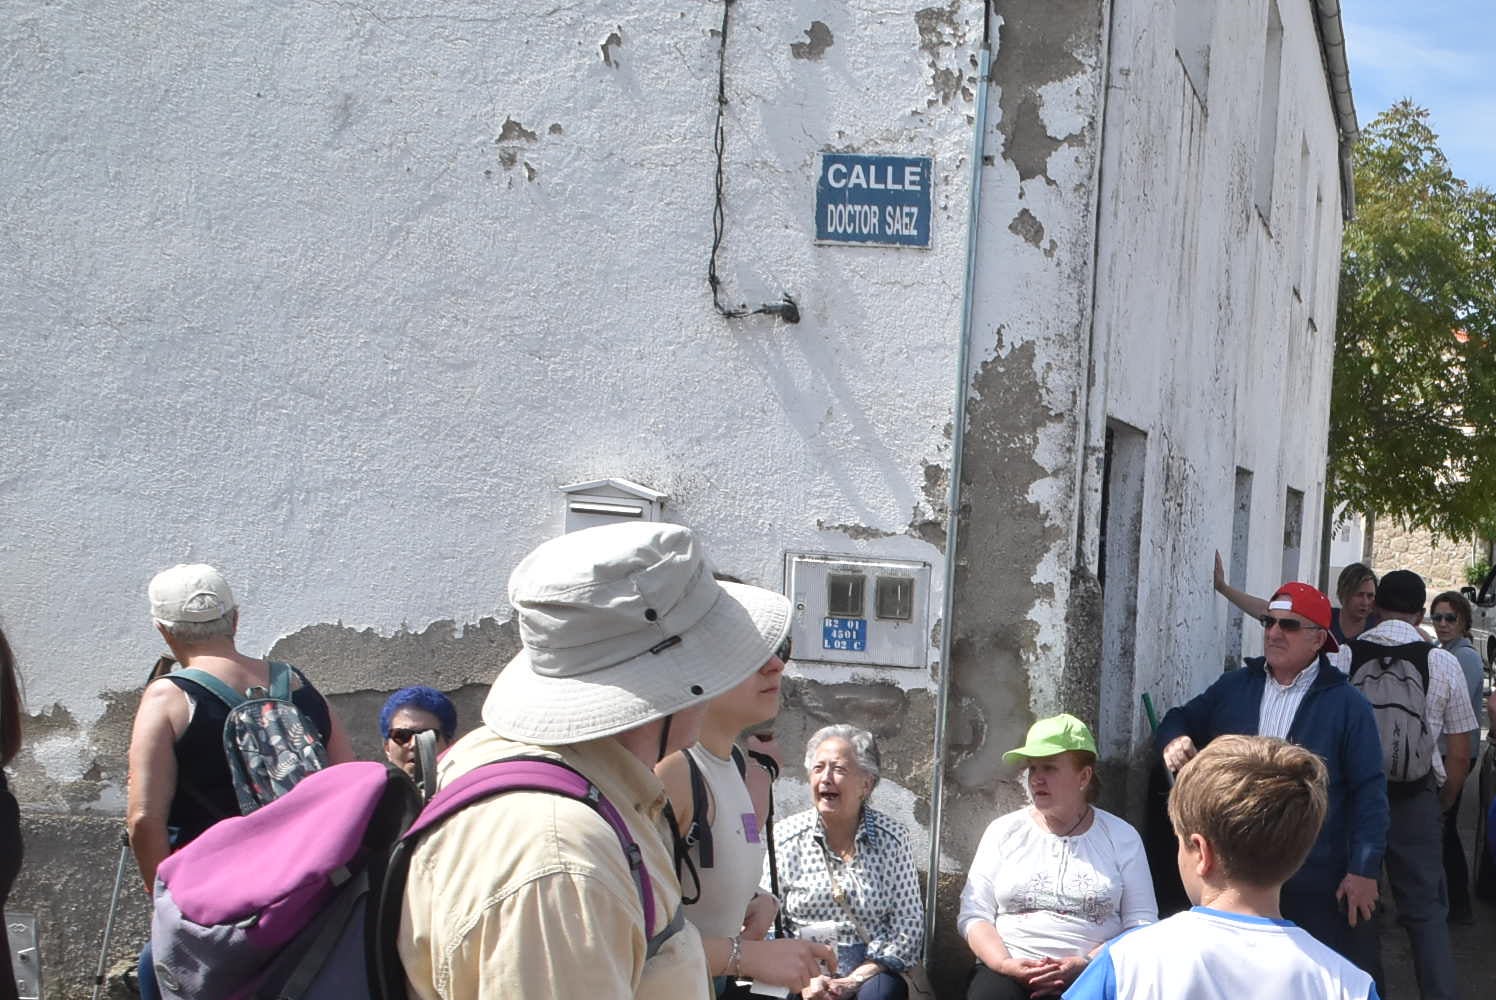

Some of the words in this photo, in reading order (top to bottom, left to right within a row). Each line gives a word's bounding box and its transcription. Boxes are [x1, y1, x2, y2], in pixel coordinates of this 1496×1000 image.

[827, 163, 922, 191] CALLE
[827, 204, 880, 234] DOCTOR
[885, 205, 919, 236] SAEZ
